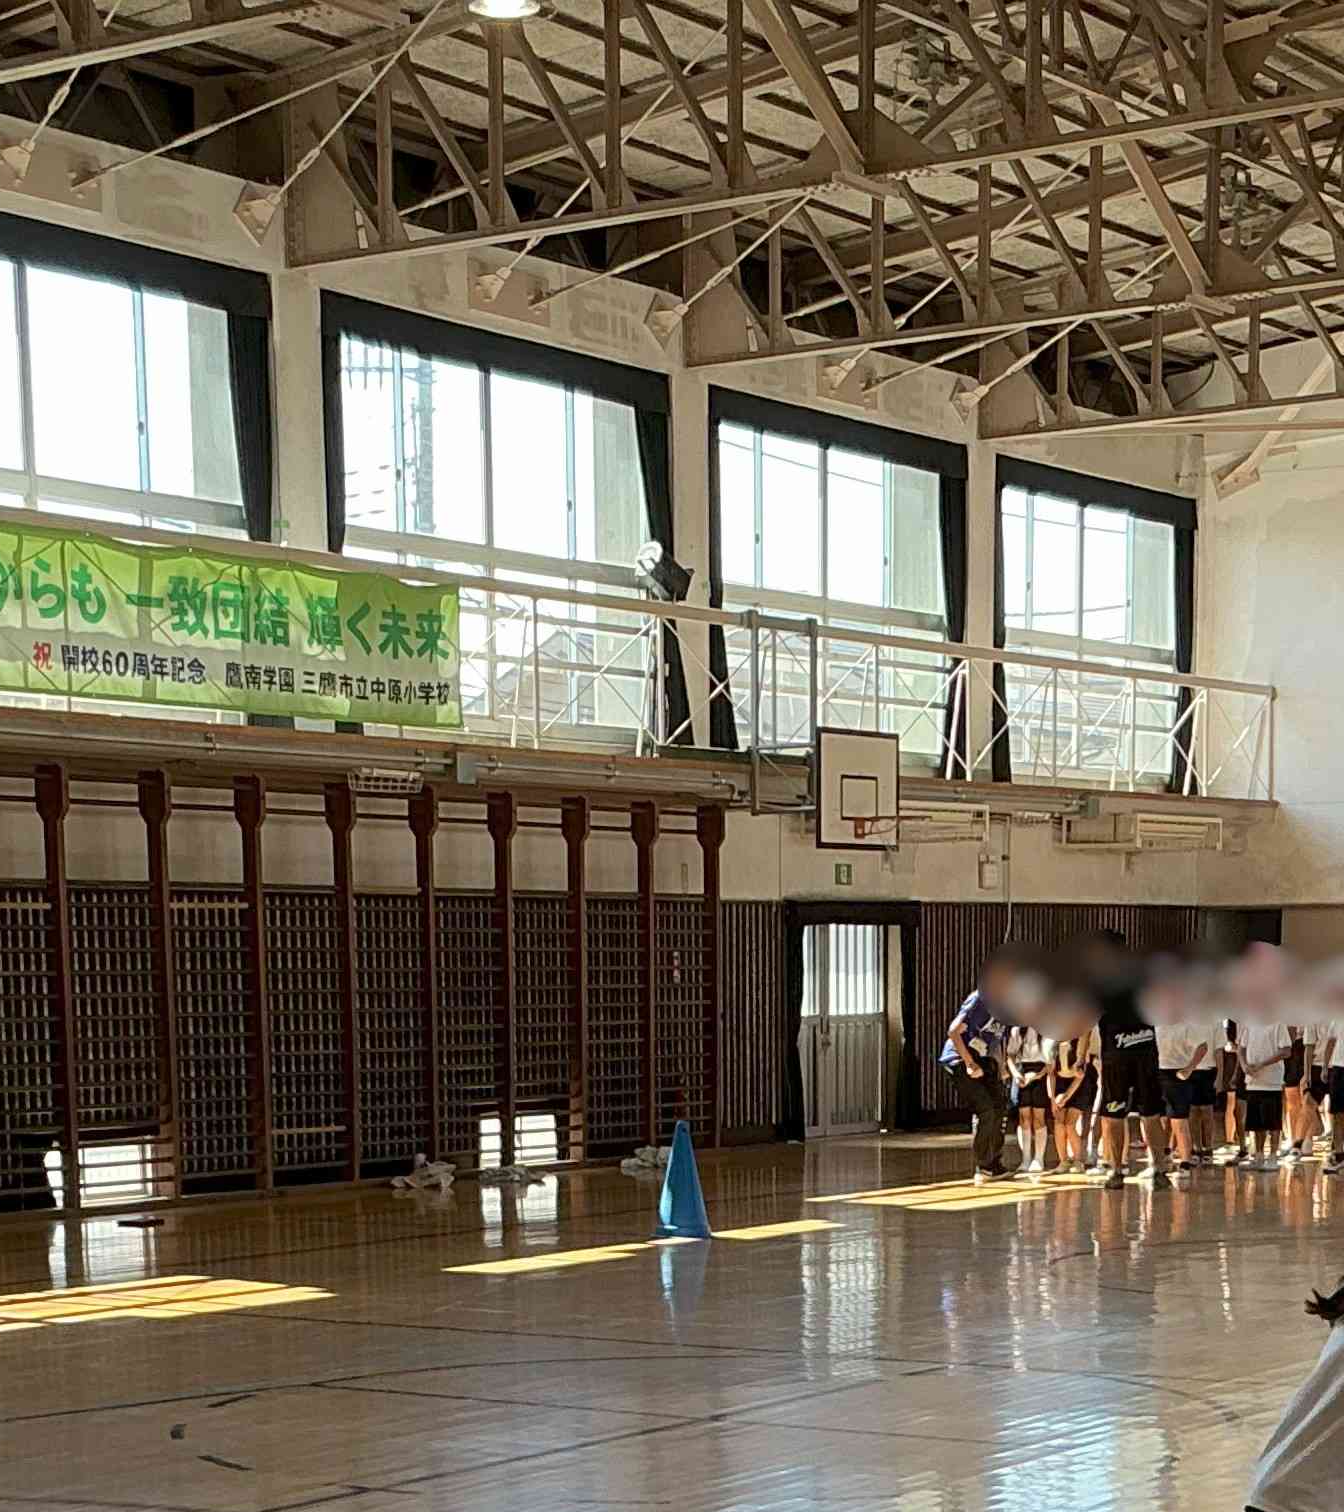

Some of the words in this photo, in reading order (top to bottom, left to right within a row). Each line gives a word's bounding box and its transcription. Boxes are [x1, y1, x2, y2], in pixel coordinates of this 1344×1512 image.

[126, 575, 290, 648] 一致団結
[307, 591, 450, 662] 輝く未来
[32, 640, 53, 671] 祝
[60, 644, 207, 685] 開校60周年記念
[302, 670, 451, 705] 三鷹市立中原小学校
